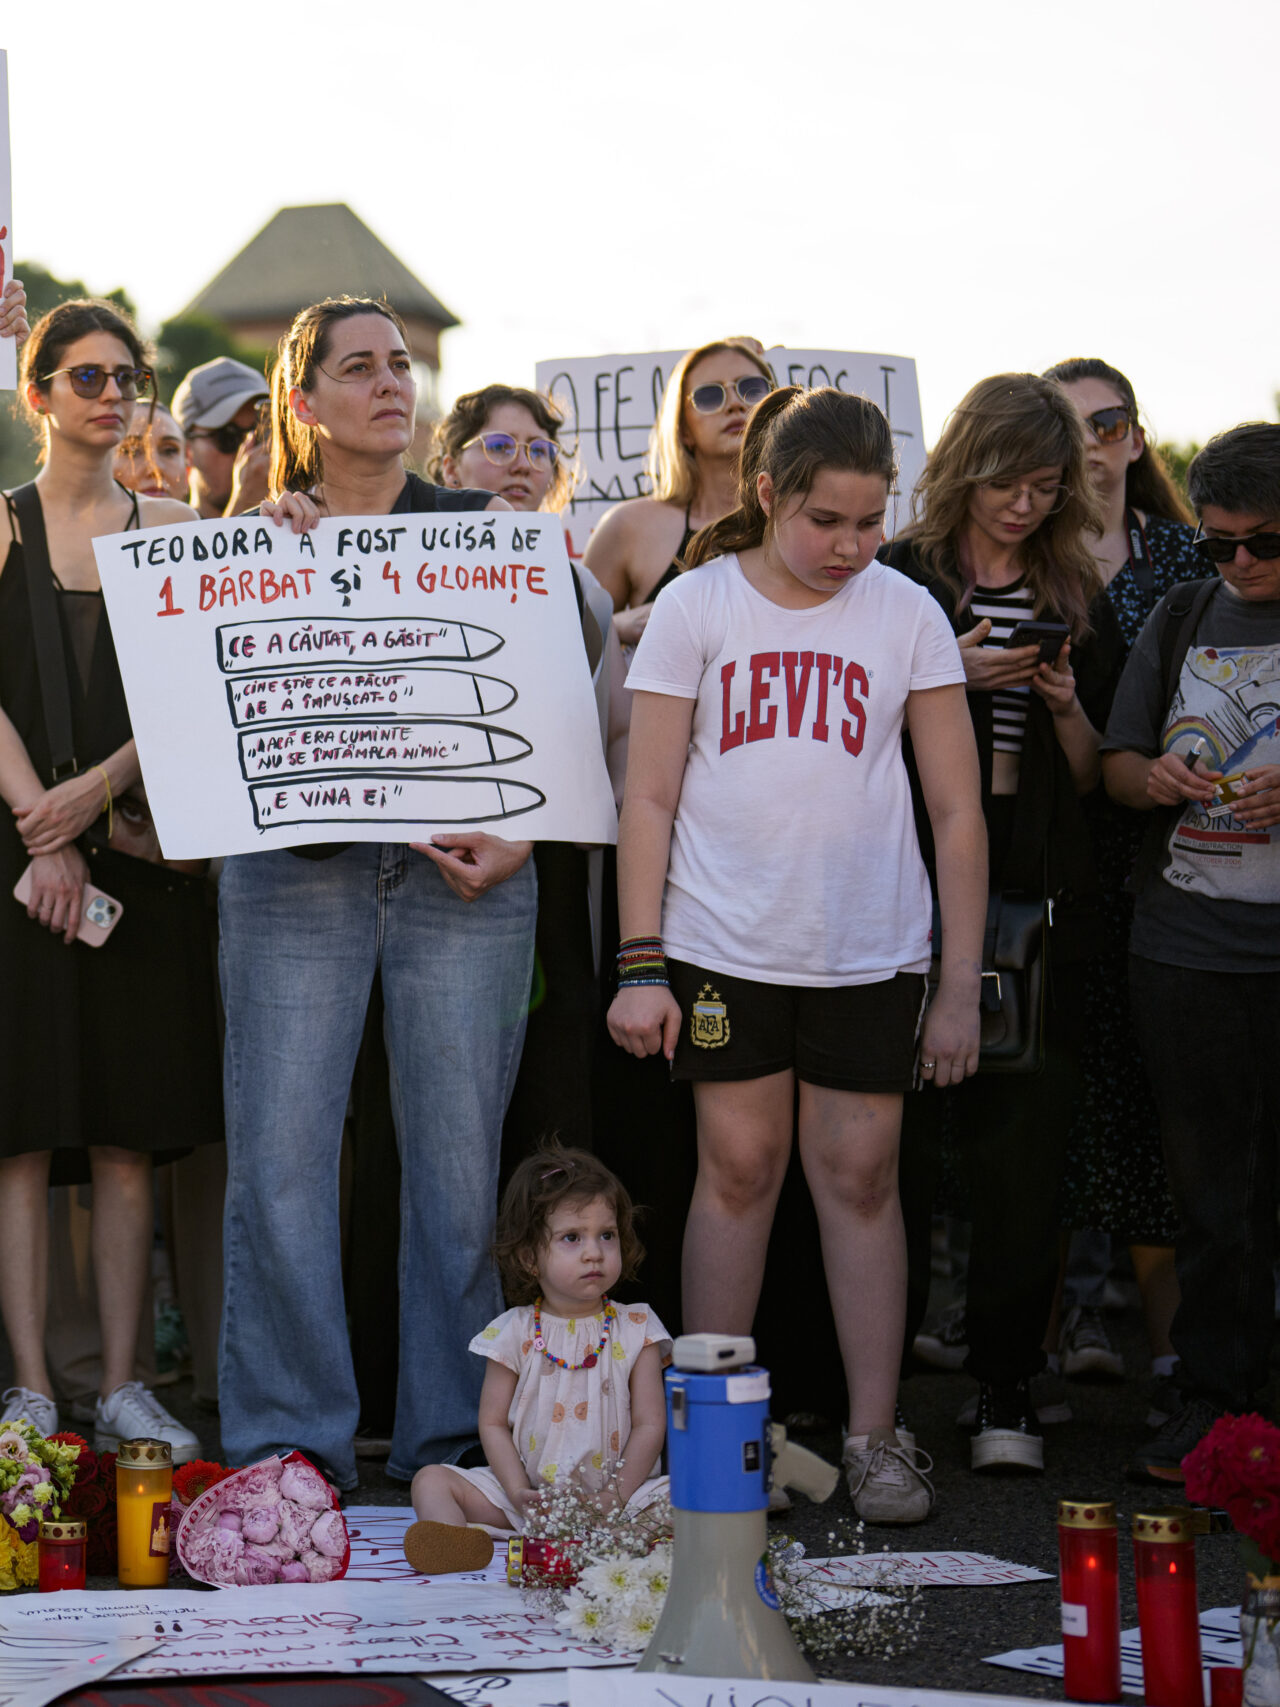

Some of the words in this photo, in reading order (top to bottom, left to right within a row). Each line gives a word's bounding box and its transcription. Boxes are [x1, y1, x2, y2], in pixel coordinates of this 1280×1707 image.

[121, 526, 273, 569] TEODORA
[299, 532, 316, 559] A
[337, 527, 408, 558] FOST
[422, 518, 497, 550] UCISĂ
[511, 528, 541, 552] DE
[156, 576, 184, 617] 1
[199, 566, 317, 611] BĂRBAT
[330, 565, 362, 607] ȘI
[382, 560, 401, 594] 4
[417, 562, 549, 604] GLOANȚE
[267, 632, 283, 654] A
[362, 630, 378, 648] A
[318, 676, 337, 688] CE
[340, 675, 352, 687] A
[281, 698, 294, 711] A
[720, 651, 870, 758] LEVI'S
[301, 730, 335, 745] ERA
[339, 726, 413, 745] CUMINTE
[257, 754, 283, 770] NU
[286, 751, 307, 766] SE
[299, 785, 351, 808] VINA
[1169, 870, 1196, 884] TATE
